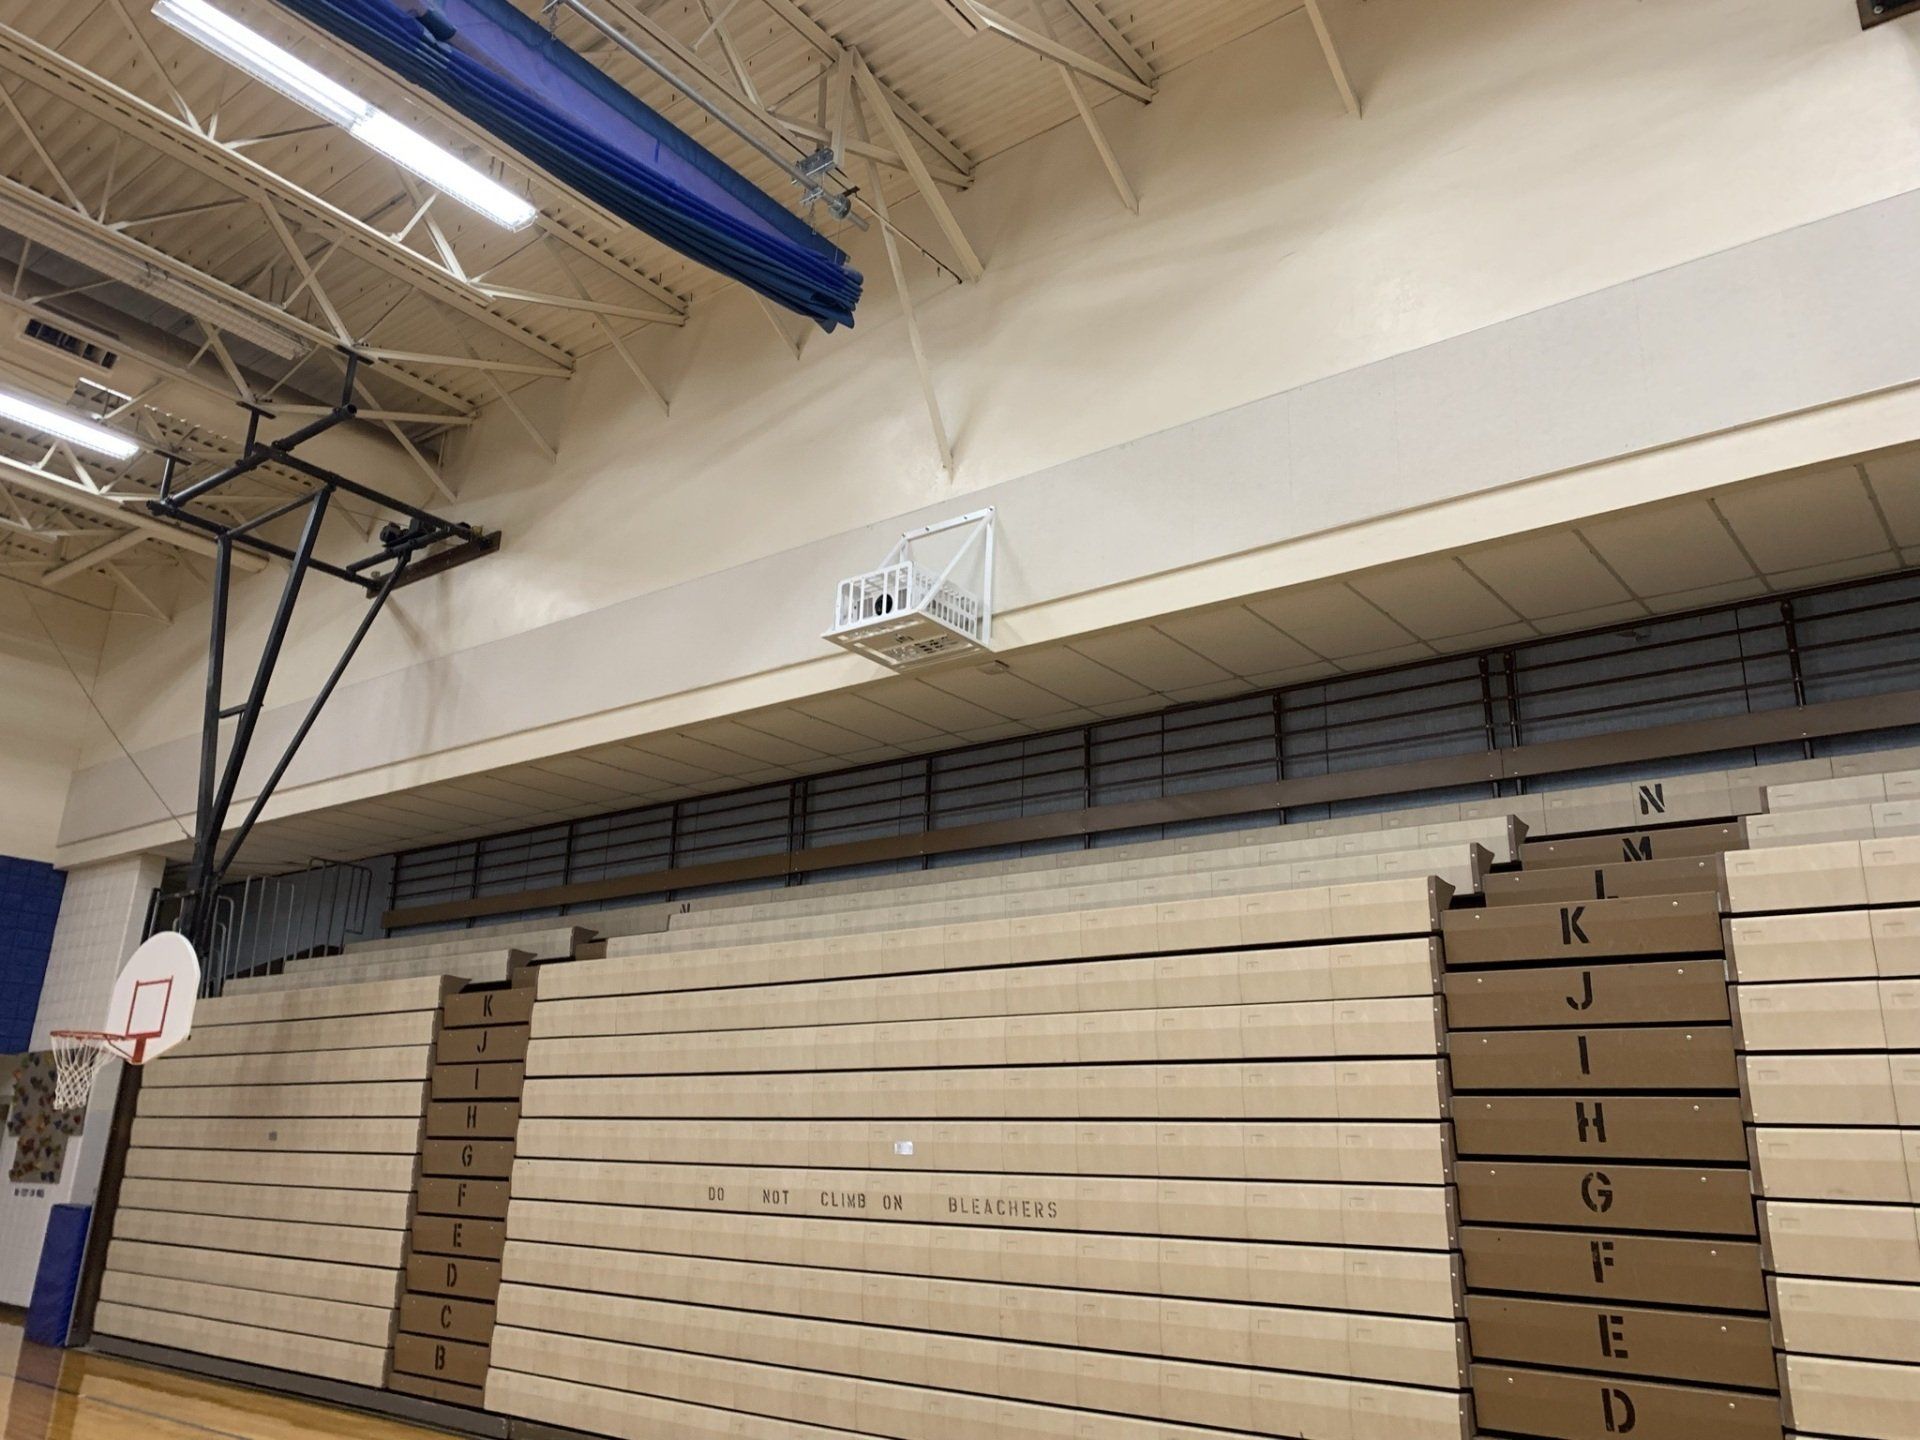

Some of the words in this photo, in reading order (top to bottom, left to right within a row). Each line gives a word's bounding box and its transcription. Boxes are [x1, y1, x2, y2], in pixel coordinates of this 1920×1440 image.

[1640, 784, 1664, 814] N
[1560, 907, 1589, 944] K
[483, 994, 493, 1017] K
[1567, 972, 1592, 1010] J
[476, 1030, 488, 1053] J
[1578, 1036, 1590, 1074] I
[466, 1105, 477, 1129] H
[1576, 1102, 1606, 1142] H
[461, 1144, 473, 1167] G
[457, 1183, 467, 1207] F
[708, 1186, 725, 1201] DO
[762, 1189, 789, 1205] NOT
[820, 1191, 866, 1209] CLIMB
[882, 1194, 903, 1211] ON
[948, 1197, 1058, 1219] BLEACHERS
[1582, 1172, 1612, 1212] G
[452, 1223, 463, 1248] E
[446, 1263, 458, 1288] D
[1591, 1242, 1613, 1283] F
[440, 1304, 452, 1329] C
[1599, 1315, 1628, 1358] E
[434, 1344, 446, 1371] B
[1602, 1389, 1635, 1433] D
